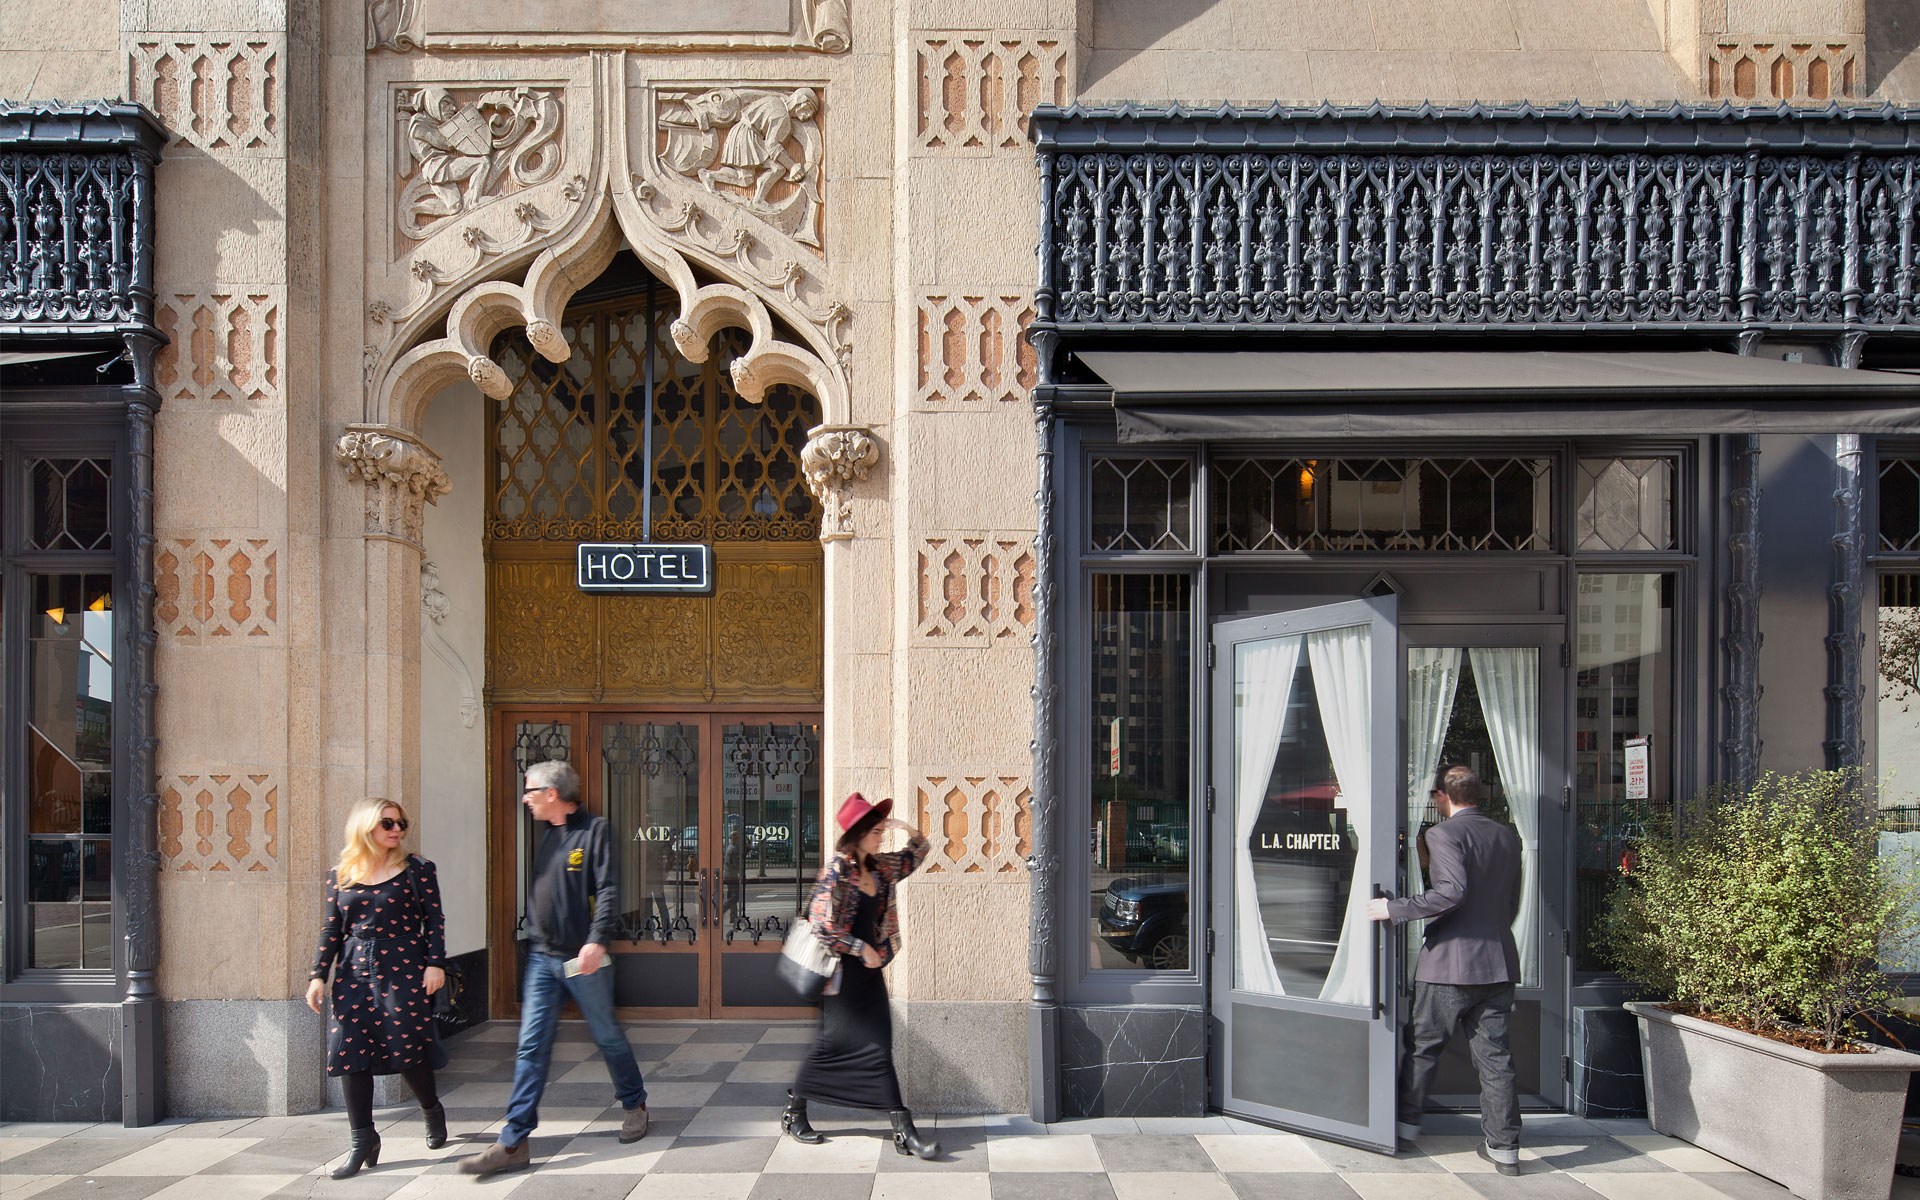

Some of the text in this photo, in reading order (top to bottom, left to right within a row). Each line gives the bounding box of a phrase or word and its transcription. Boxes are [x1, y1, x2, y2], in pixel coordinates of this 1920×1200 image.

[587, 553, 698, 580] HOTEL
[633, 826, 670, 841] ACE
[754, 826, 790, 841] 929
[1261, 833, 1340, 850] L.A. CHAPTER
